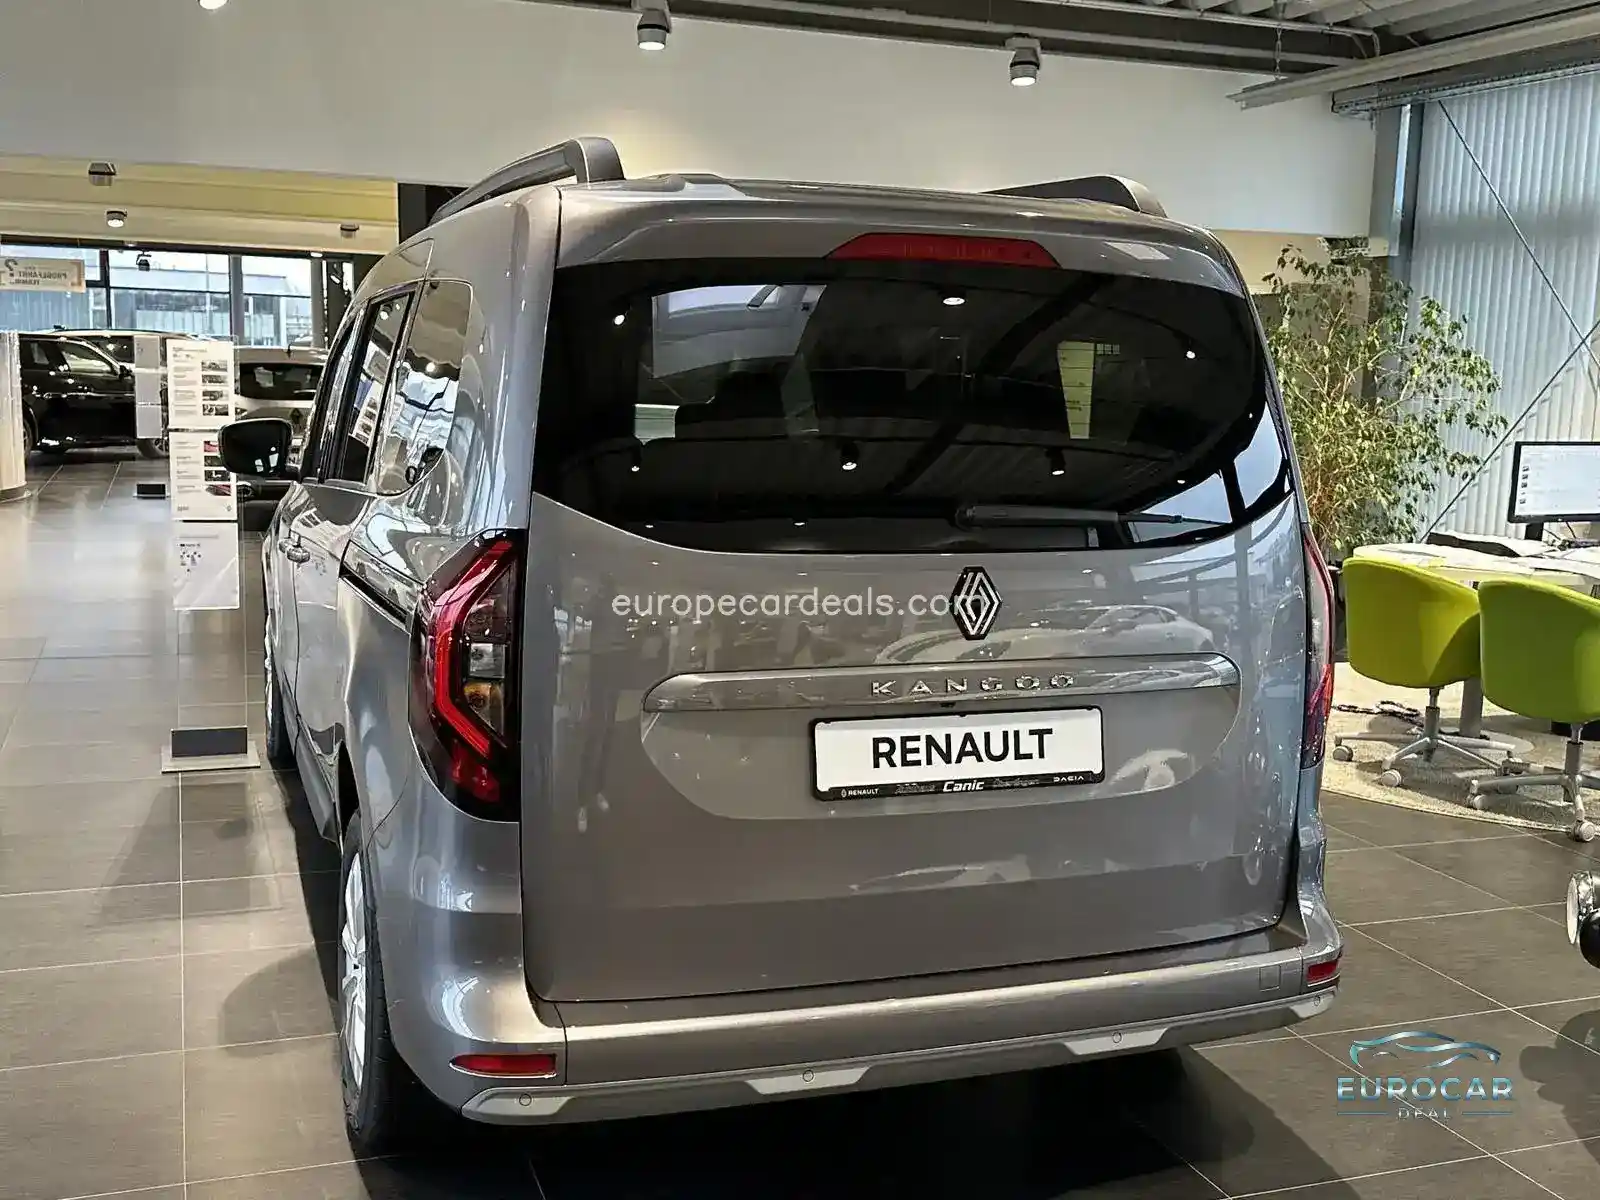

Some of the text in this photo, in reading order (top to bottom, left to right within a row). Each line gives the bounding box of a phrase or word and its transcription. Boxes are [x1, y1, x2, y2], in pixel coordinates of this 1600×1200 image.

[870, 673, 1075, 697] KANGOO
[872, 728, 1053, 768] RENAULT
[848, 788, 879, 796] RENAULT
[942, 779, 985, 792] Canic
[1053, 775, 1085, 783] DACIA
